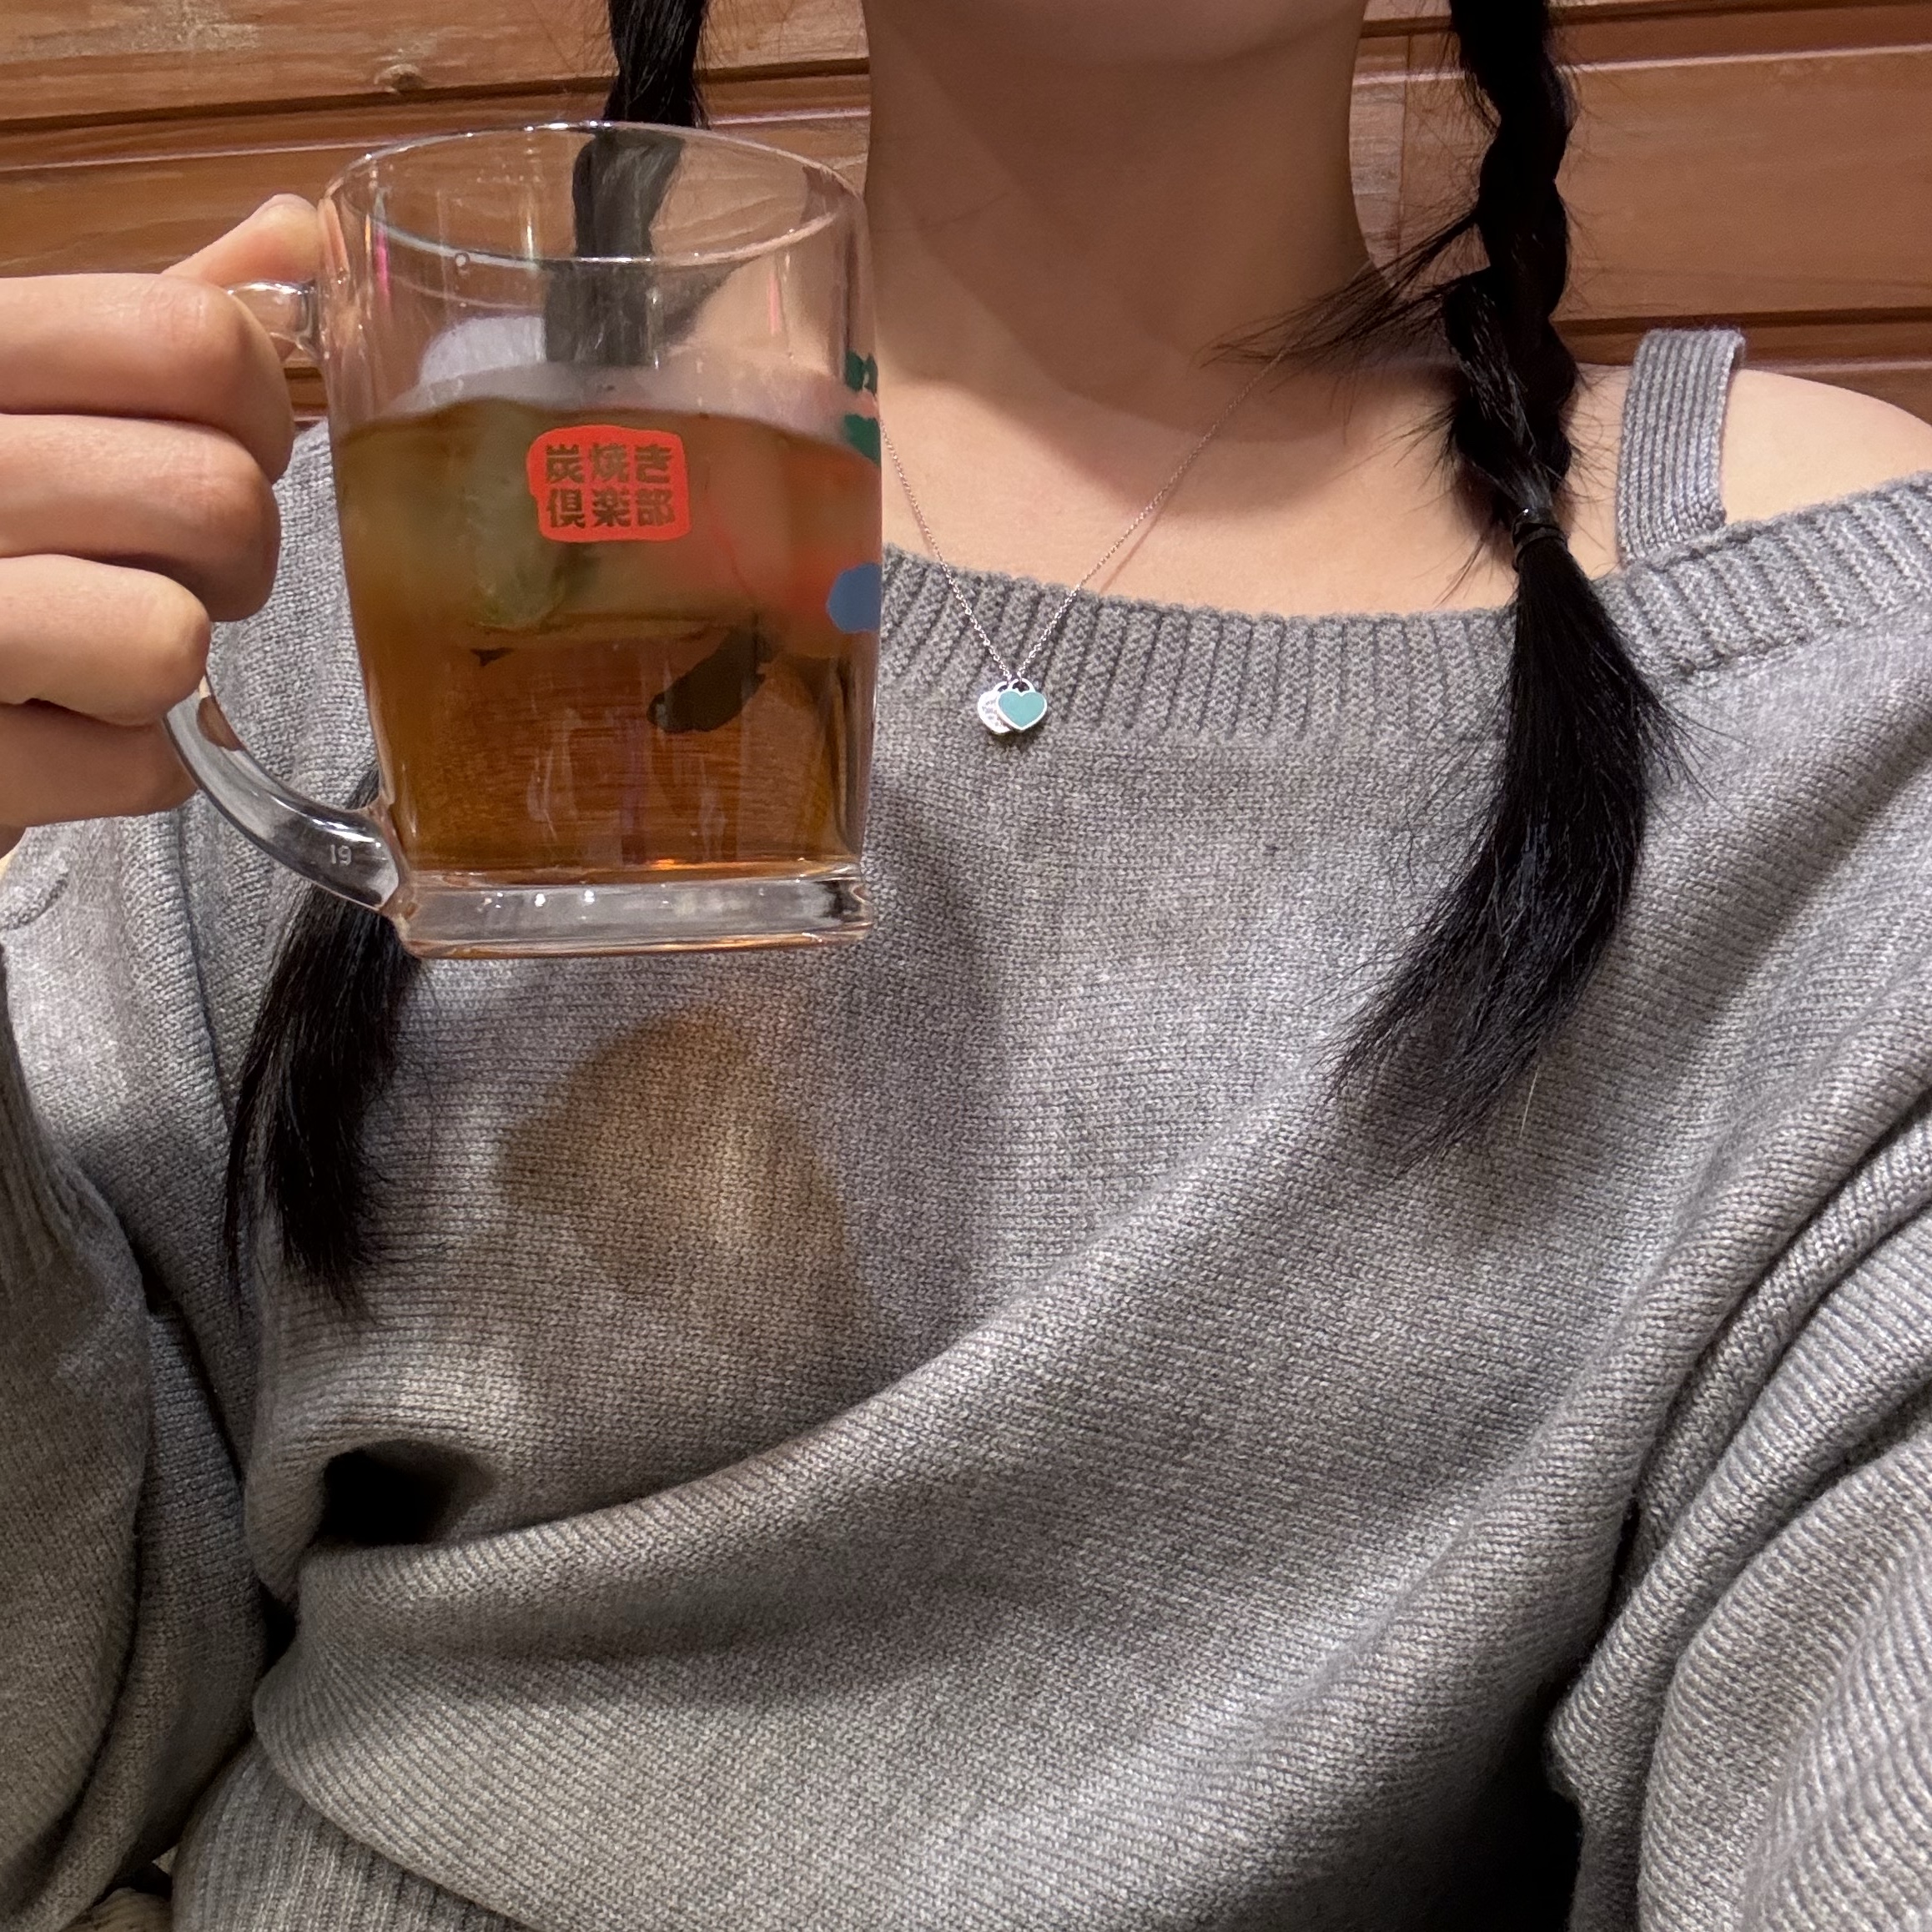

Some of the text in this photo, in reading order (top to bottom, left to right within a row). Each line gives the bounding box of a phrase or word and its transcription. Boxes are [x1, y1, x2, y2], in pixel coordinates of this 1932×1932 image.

[546, 444, 672, 483] 炭焼き
[546, 489, 675, 527] 倶楽部
[330, 844, 351, 866] 19
